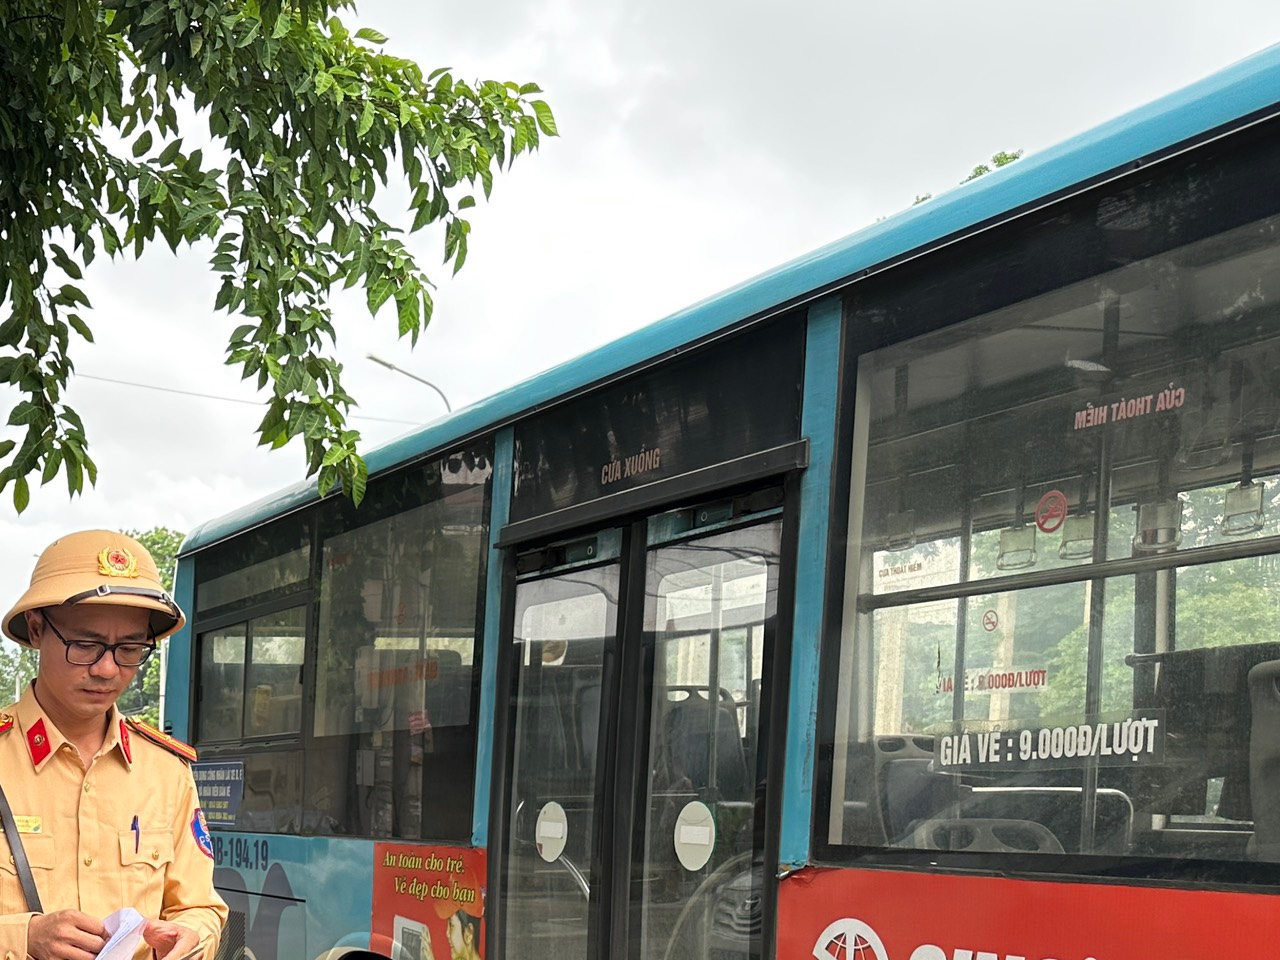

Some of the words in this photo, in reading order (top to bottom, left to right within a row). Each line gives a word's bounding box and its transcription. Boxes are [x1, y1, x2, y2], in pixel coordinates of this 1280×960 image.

[623, 443, 661, 478] XUỐNG
[940, 729, 971, 766] GIÁ
[1019, 718, 1159, 762] 9.000Đ/LƯỢT
[383, 850, 396, 867] An
[398, 851, 422, 869] toàn
[424, 852, 444, 872] cho
[408, 877, 429, 901] đẹp
[430, 880, 450, 900] cho
[452, 880, 475, 906] bạn
